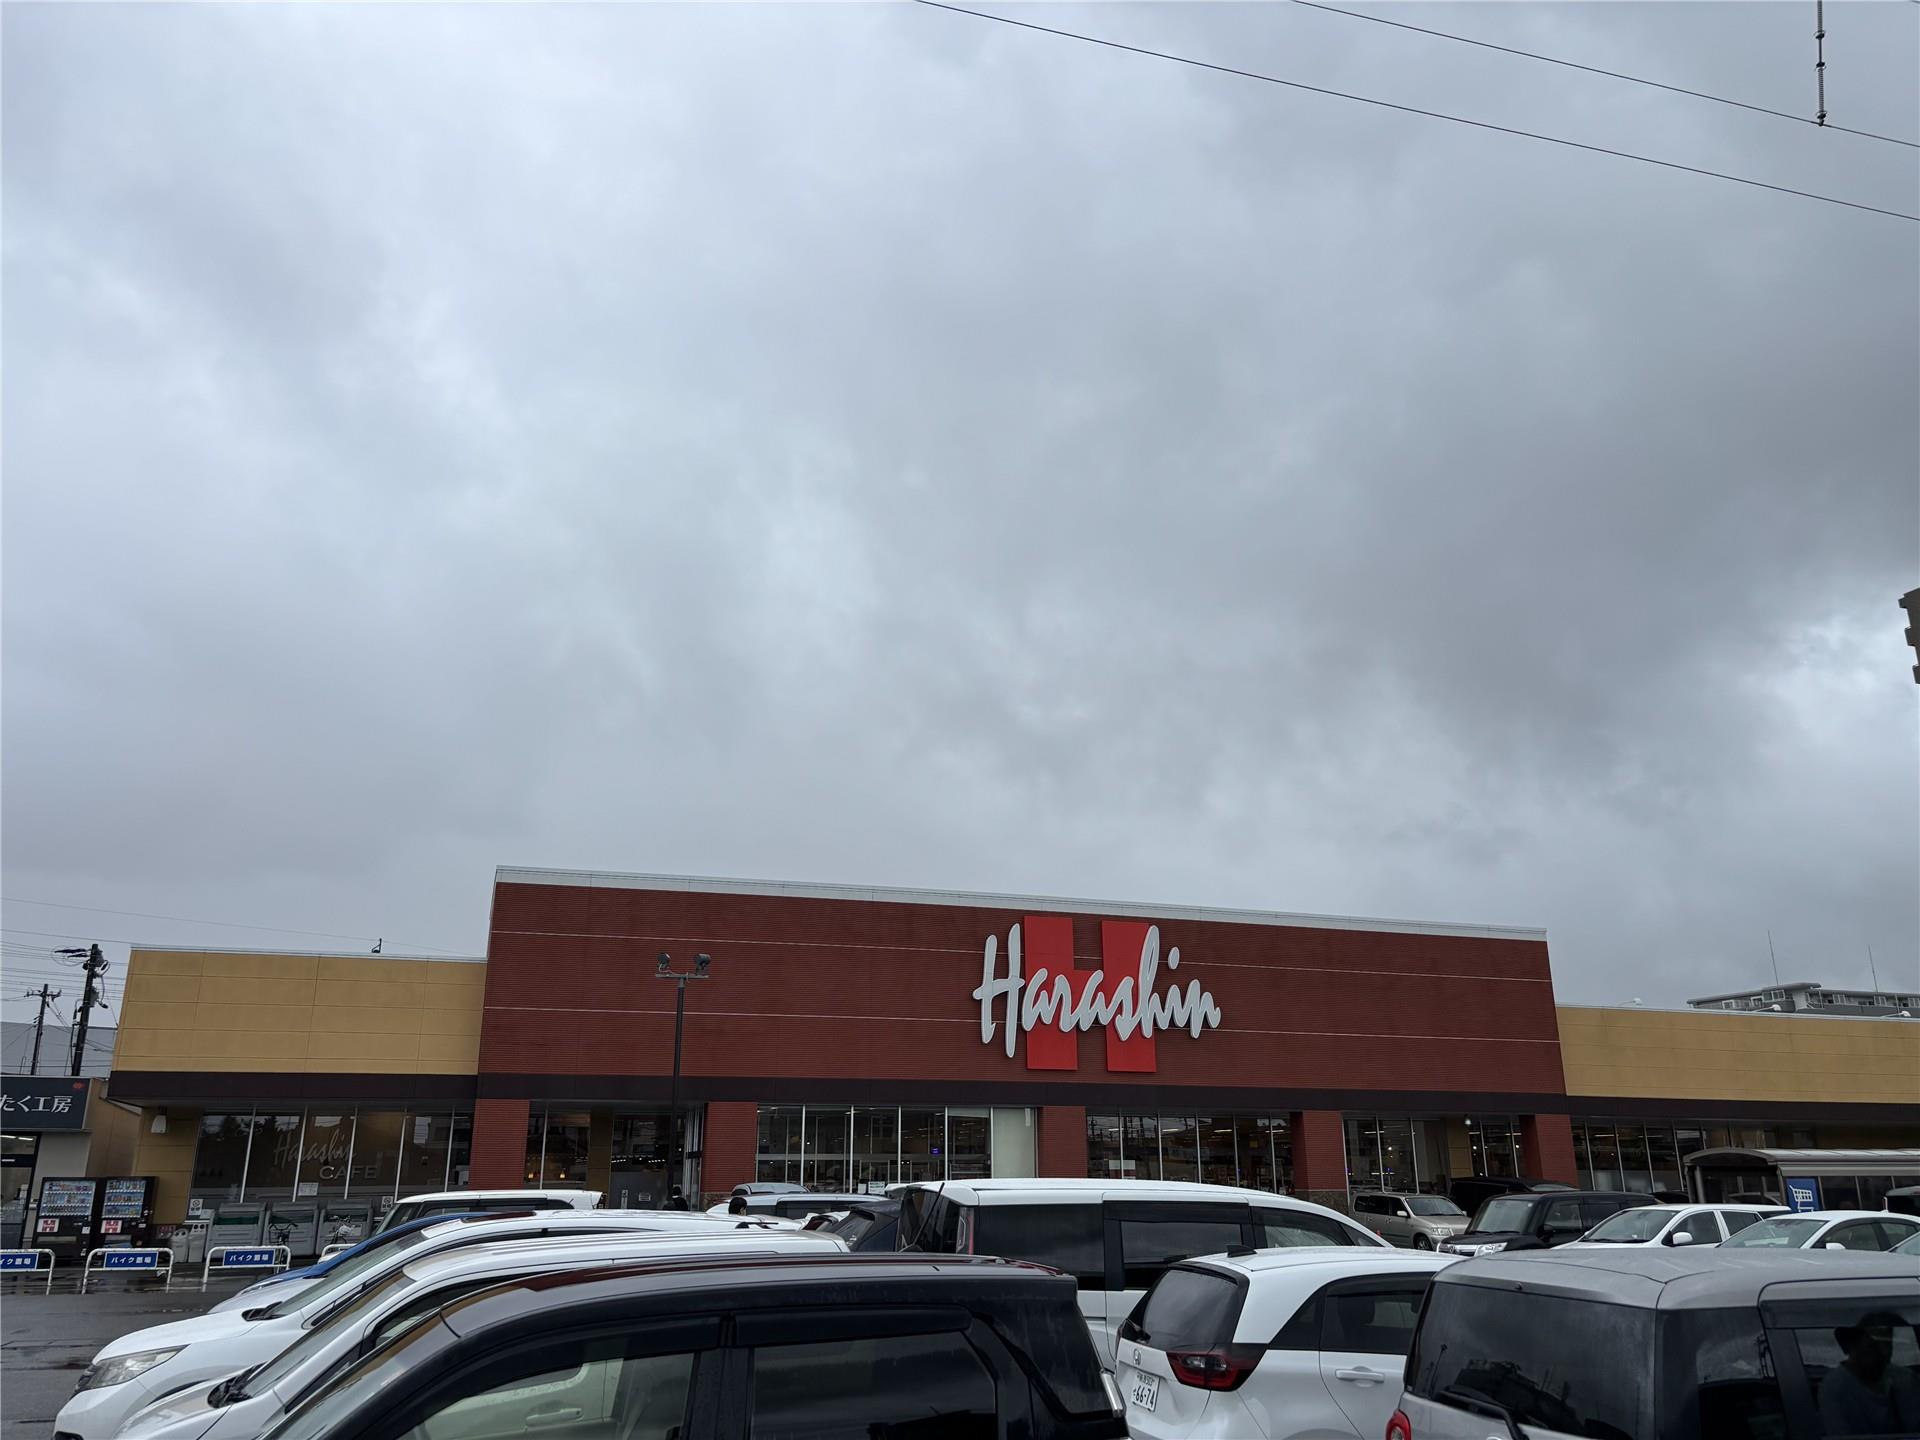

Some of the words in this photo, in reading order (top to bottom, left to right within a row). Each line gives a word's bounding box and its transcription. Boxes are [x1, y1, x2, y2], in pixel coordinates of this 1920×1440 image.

[973, 923, 1221, 1058] Harashin
[274, 1128, 359, 1169] Harashin
[320, 1165, 378, 1180] CAFE
